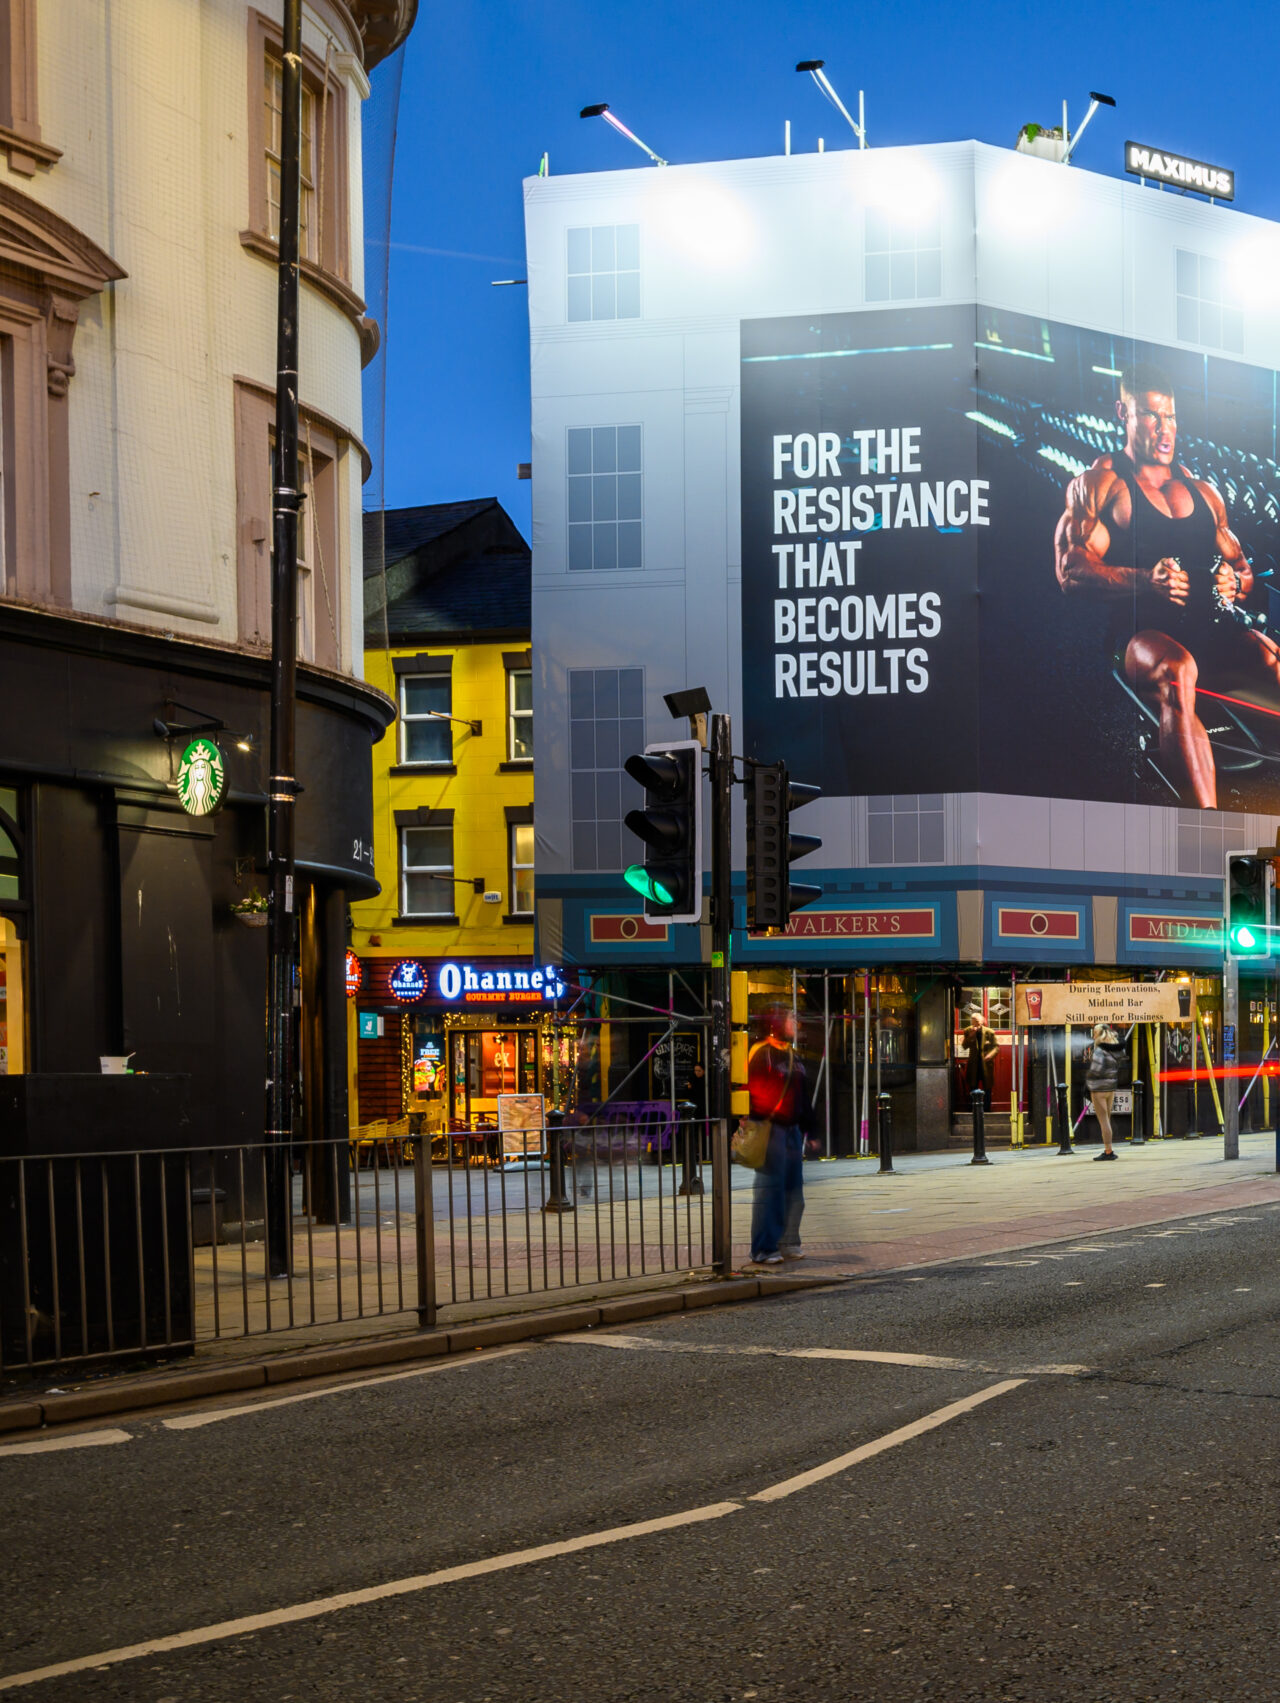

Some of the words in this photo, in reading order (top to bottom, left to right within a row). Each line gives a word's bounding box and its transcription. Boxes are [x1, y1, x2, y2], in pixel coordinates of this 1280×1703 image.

[1130, 147, 1230, 193] MAXIMUS
[773, 432, 841, 480] FOR
[853, 427, 921, 475] THE
[773, 479, 990, 534] RESISTANCE
[771, 540, 862, 588] THAT
[774, 592, 941, 643] BECOMES
[774, 648, 929, 698] RESULTS
[784, 915, 901, 934] WALKER'S
[1148, 920, 1218, 939] MIDLA
[465, 992, 506, 1002] GOURMET
[508, 992, 542, 1001] BURGER
[1069, 984, 1101, 995] During
[1104, 984, 1161, 994] Renovations,
[1088, 999, 1124, 1007] Midland
[1127, 999, 1144, 1007] Bar
[1065, 1013, 1085, 1022] Still
[1087, 1015, 1109, 1024] open
[1112, 1013, 1125, 1022] for
[1127, 1013, 1164, 1022] Business
